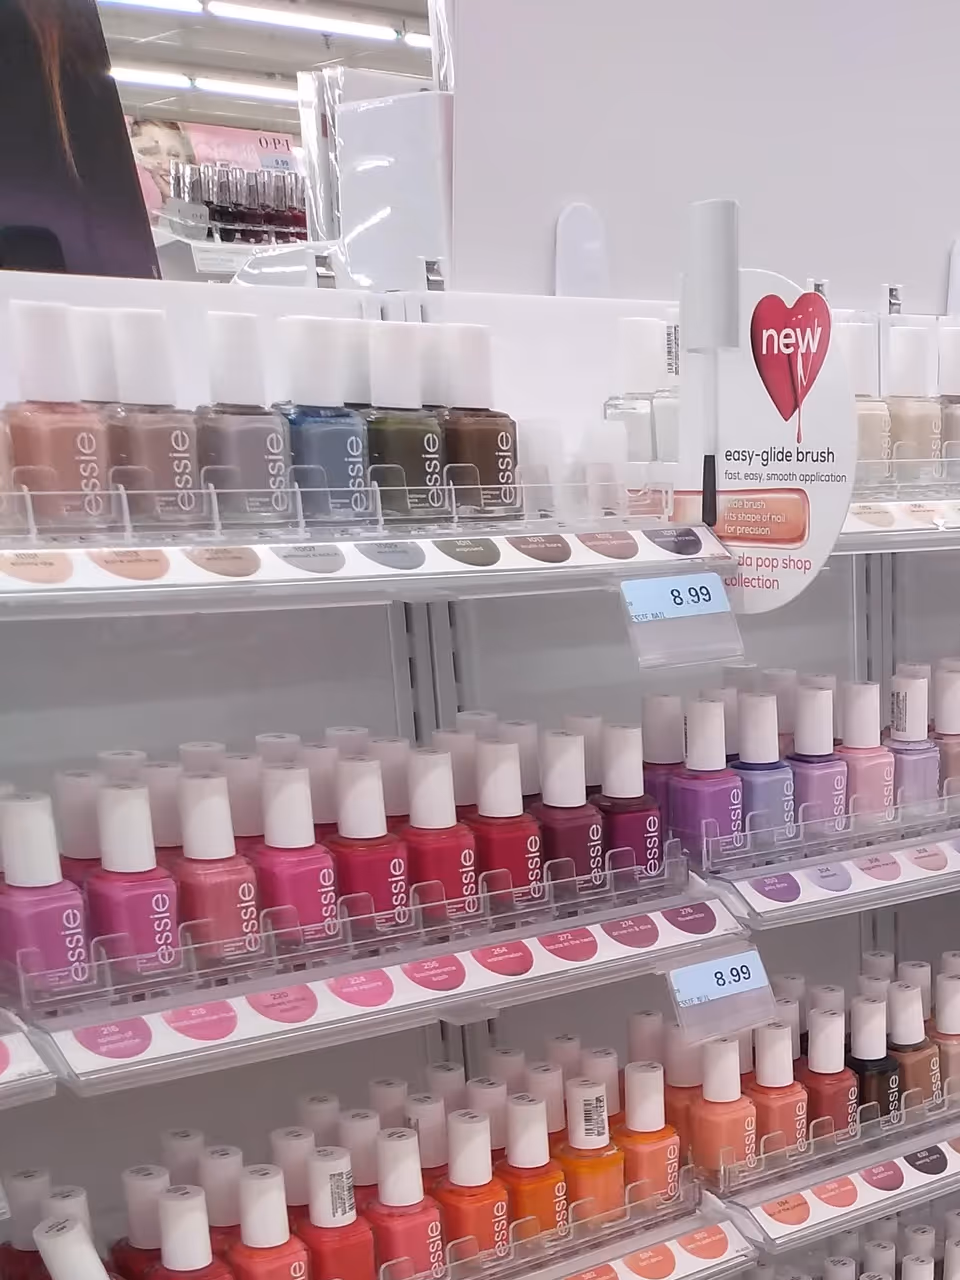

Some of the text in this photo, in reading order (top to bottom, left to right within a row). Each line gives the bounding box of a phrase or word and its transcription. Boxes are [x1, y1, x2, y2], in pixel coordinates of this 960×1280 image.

[762, 321, 822, 355] new
[75, 431, 103, 516] essie
[169, 429, 195, 511] essie
[265, 433, 289, 511] essie
[345, 435, 367, 511] essie
[422, 433, 444, 507] essie
[495, 431, 515, 503] essie
[724, 447, 835, 467] easy-glide brush
[766, 471, 797, 482] smooth
[798, 471, 847, 484] application
[724, 524, 771, 536] for precision
[738, 512, 762, 524] shape
[763, 512, 770, 522] of
[771, 512, 786, 523] nail
[743, 499, 766, 509] brush
[724, 573, 780, 589] collection
[756, 555, 812, 573] pop shop
[670, 584, 712, 607] 8.99
[644, 815, 659, 876] essie
[728, 788, 744, 847] essie
[459, 849, 478, 912] essie
[525, 835, 545, 897] essie
[588, 823, 604, 885] essie
[236, 882, 261, 951] essie
[318, 868, 339, 935] essie
[388, 858, 409, 923] essie
[61, 908, 89, 981] essie
[150, 893, 175, 963] essie
[558, 933, 572, 941] 272
[619, 920, 634, 928] 274
[714, 964, 752, 988] 8.99
[492, 1200, 508, 1257] essie
[554, 1181, 567, 1237] essie
[428, 1220, 443, 1279] essie
